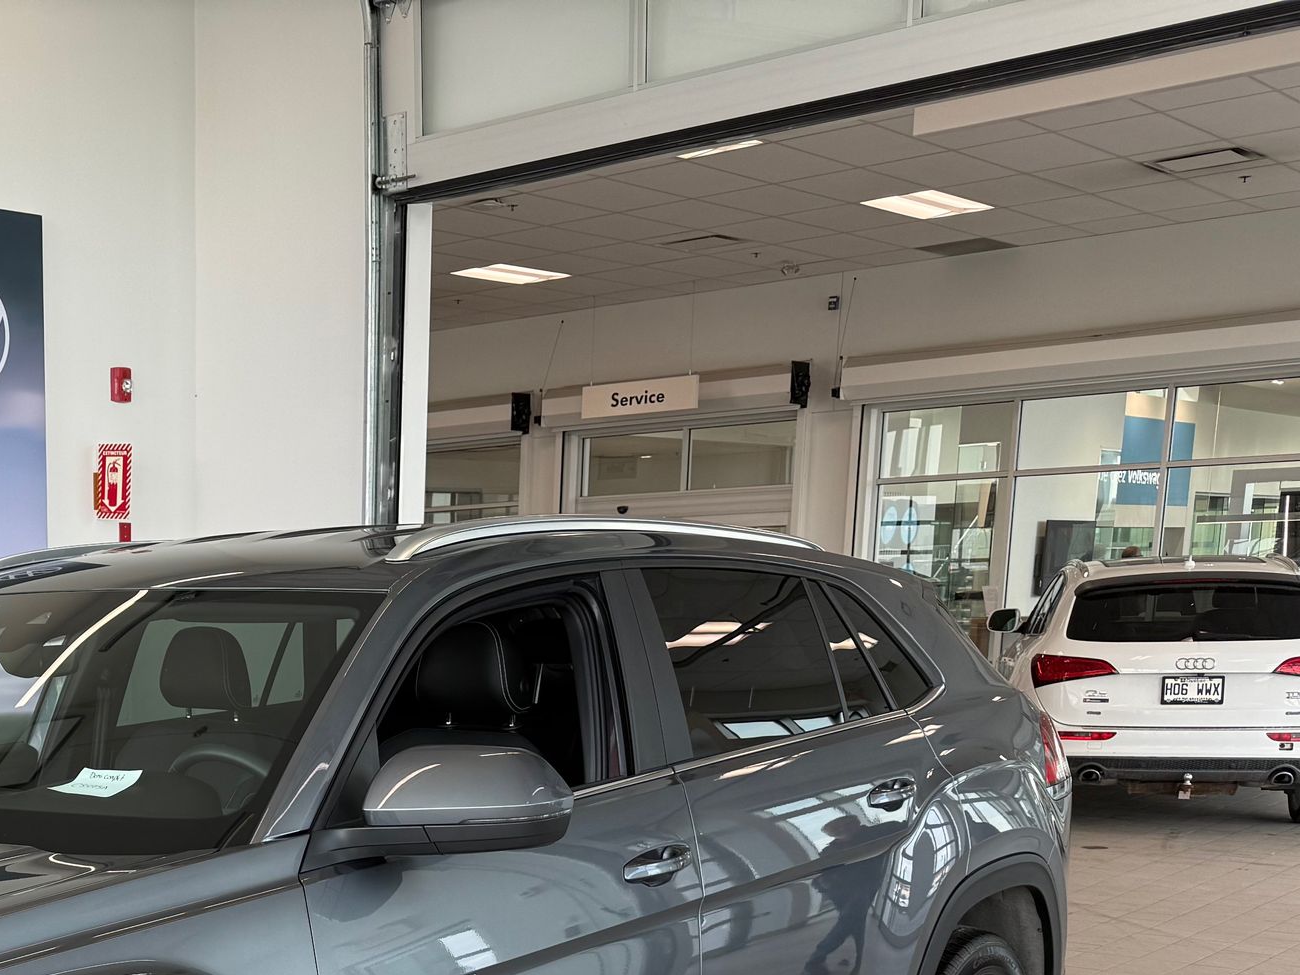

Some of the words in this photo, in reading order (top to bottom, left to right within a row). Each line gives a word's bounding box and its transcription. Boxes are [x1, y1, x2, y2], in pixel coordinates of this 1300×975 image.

[610, 389, 666, 408] Service
[1165, 683, 1189, 696] H06
[1197, 683, 1221, 696] WWX
